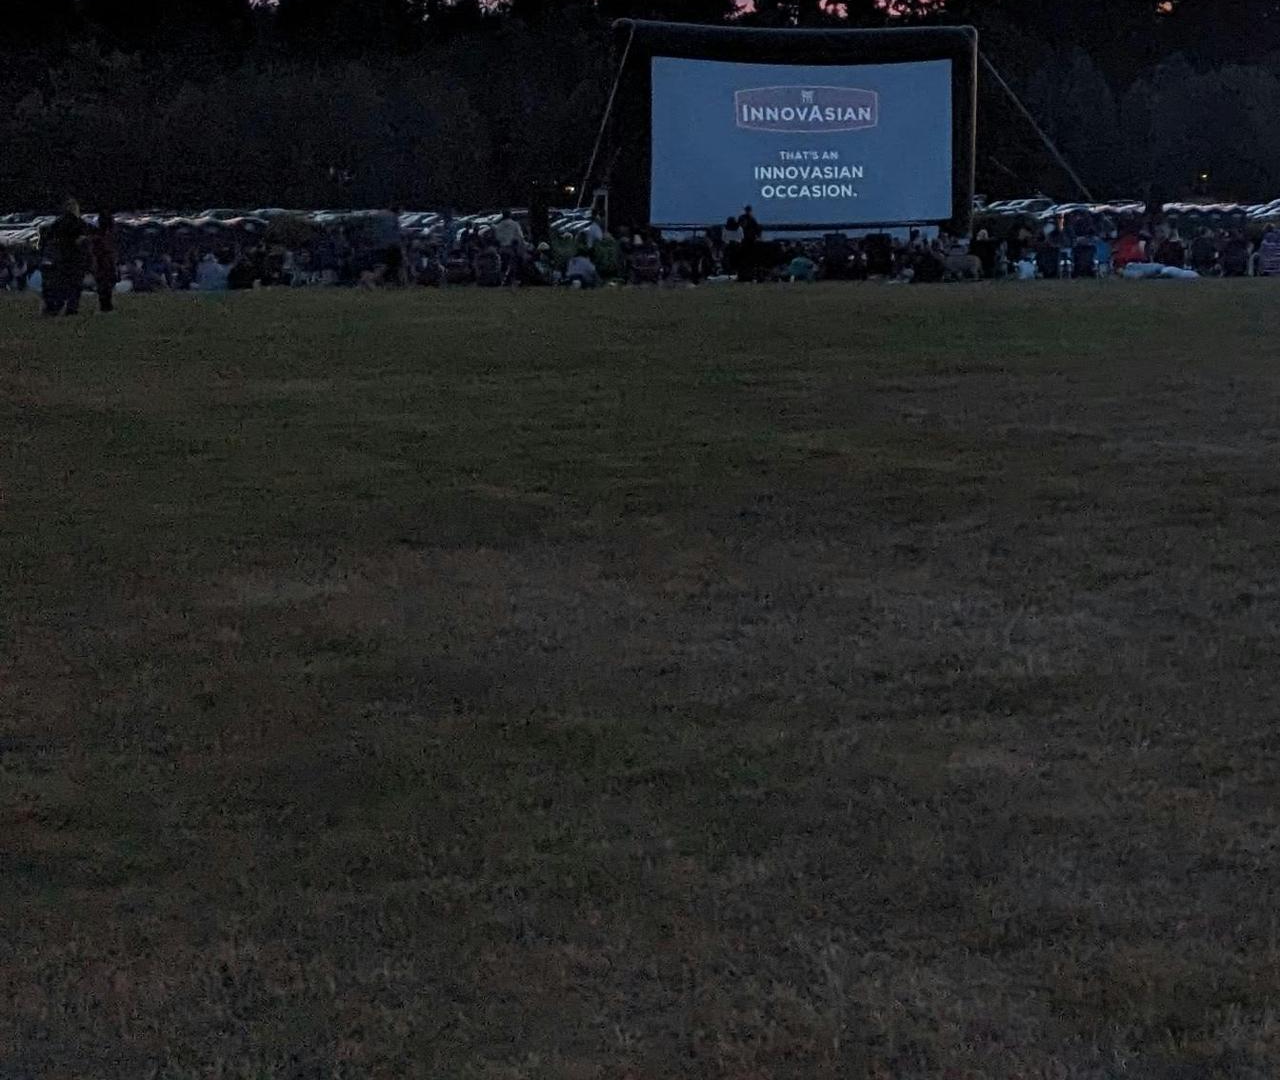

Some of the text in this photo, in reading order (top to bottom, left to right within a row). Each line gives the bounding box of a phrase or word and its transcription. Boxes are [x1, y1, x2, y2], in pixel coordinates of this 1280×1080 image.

[779, 150, 839, 161] THAT'S AN
[754, 166, 864, 180] INNOVASIAN
[761, 184, 858, 199] OCCASION.
